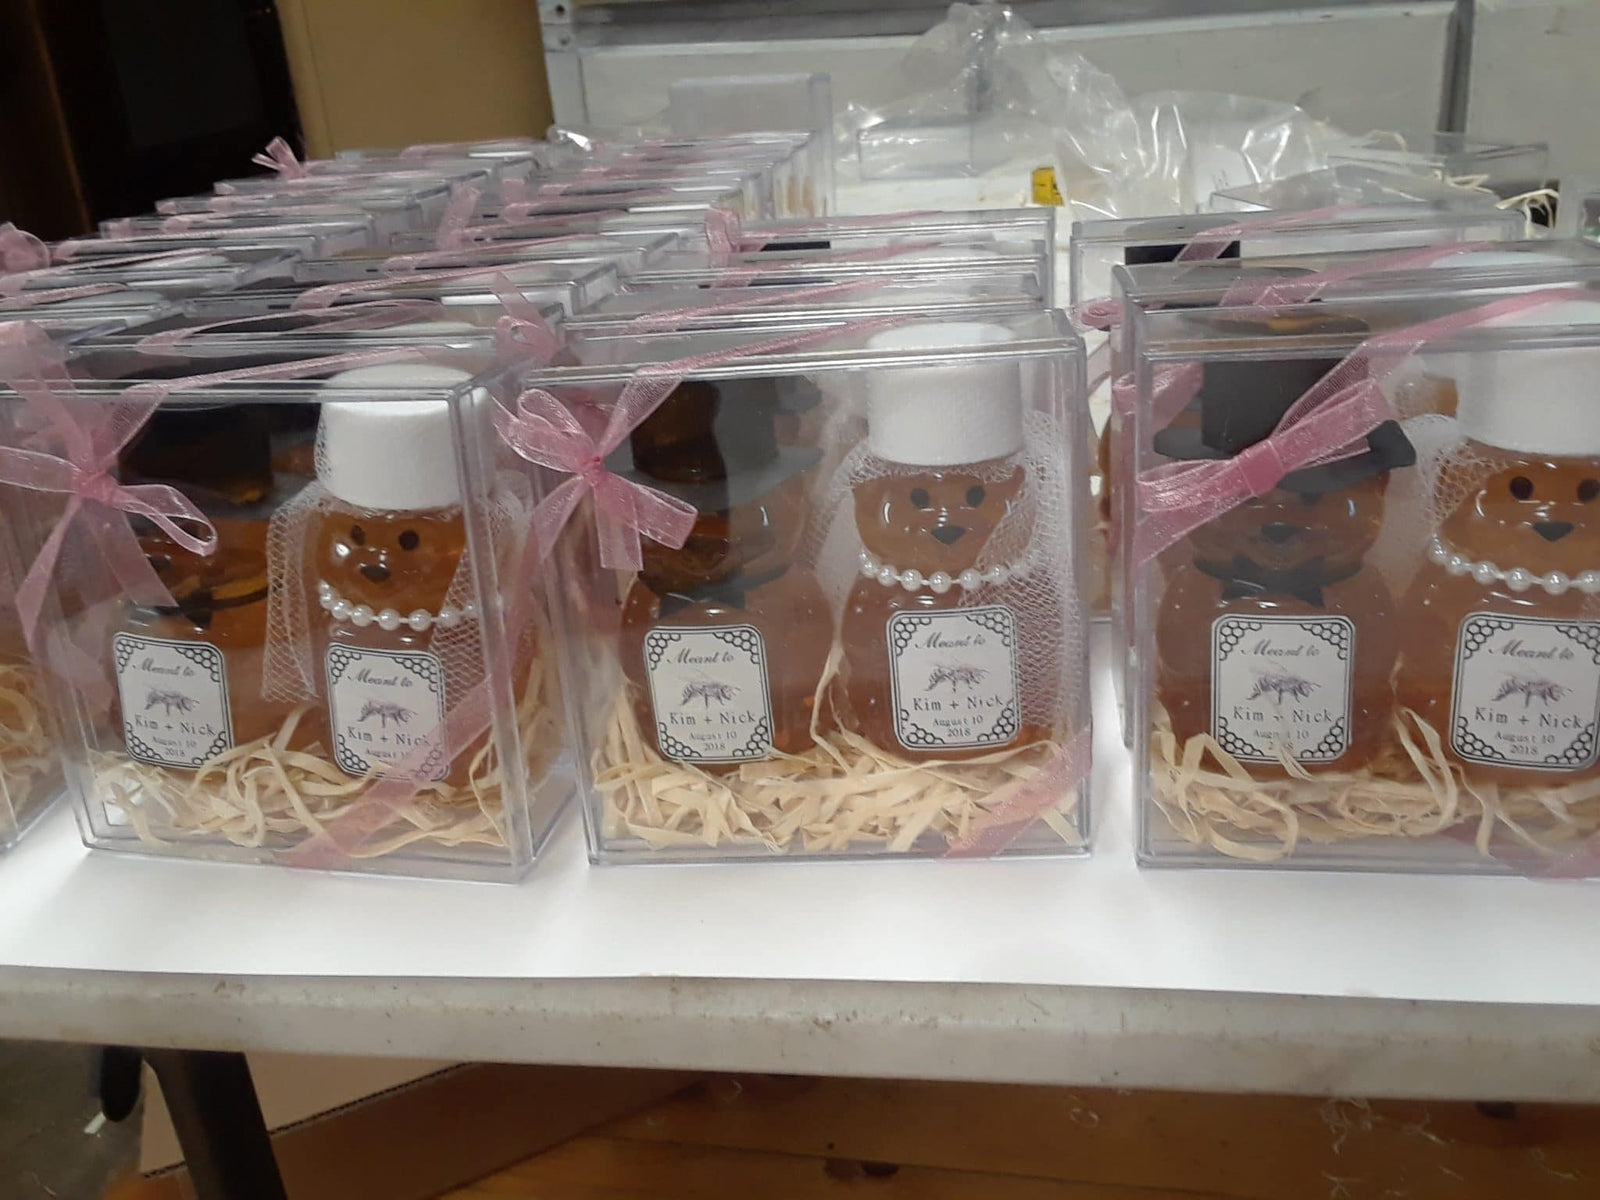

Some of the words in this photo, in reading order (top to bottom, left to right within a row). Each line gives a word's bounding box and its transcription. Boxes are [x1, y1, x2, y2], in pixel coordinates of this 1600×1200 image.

[973, 634, 986, 645] to
[1306, 645, 1319, 656] to
[1559, 648, 1574, 660] to
[722, 652, 734, 662] to
[183, 666, 195, 676] to
[400, 677, 413, 687] to
[913, 698, 942, 711] Kim
[967, 695, 1003, 709] Nick
[670, 712, 696, 725] Kim
[720, 710, 756, 725] Nick
[1234, 706, 1263, 720] Kim
[1293, 708, 1332, 722] Nick
[1475, 707, 1508, 724] Kim
[1539, 713, 1582, 729] Nick
[135, 714, 158, 729] Kim
[180, 721, 216, 736] Nick
[933, 717, 968, 726] August
[973, 715, 983, 725] 10
[348, 726, 373, 741] Kim
[690, 732, 721, 740] August
[726, 731, 737, 739] 10
[948, 728, 971, 737] 2018
[1297, 729, 1309, 739] 10
[1496, 732, 1535, 743] August
[1541, 735, 1555, 744] 10
[186, 740, 197, 748] 10
[704, 743, 725, 751] 2018
[1510, 744, 1538, 755] 2018
